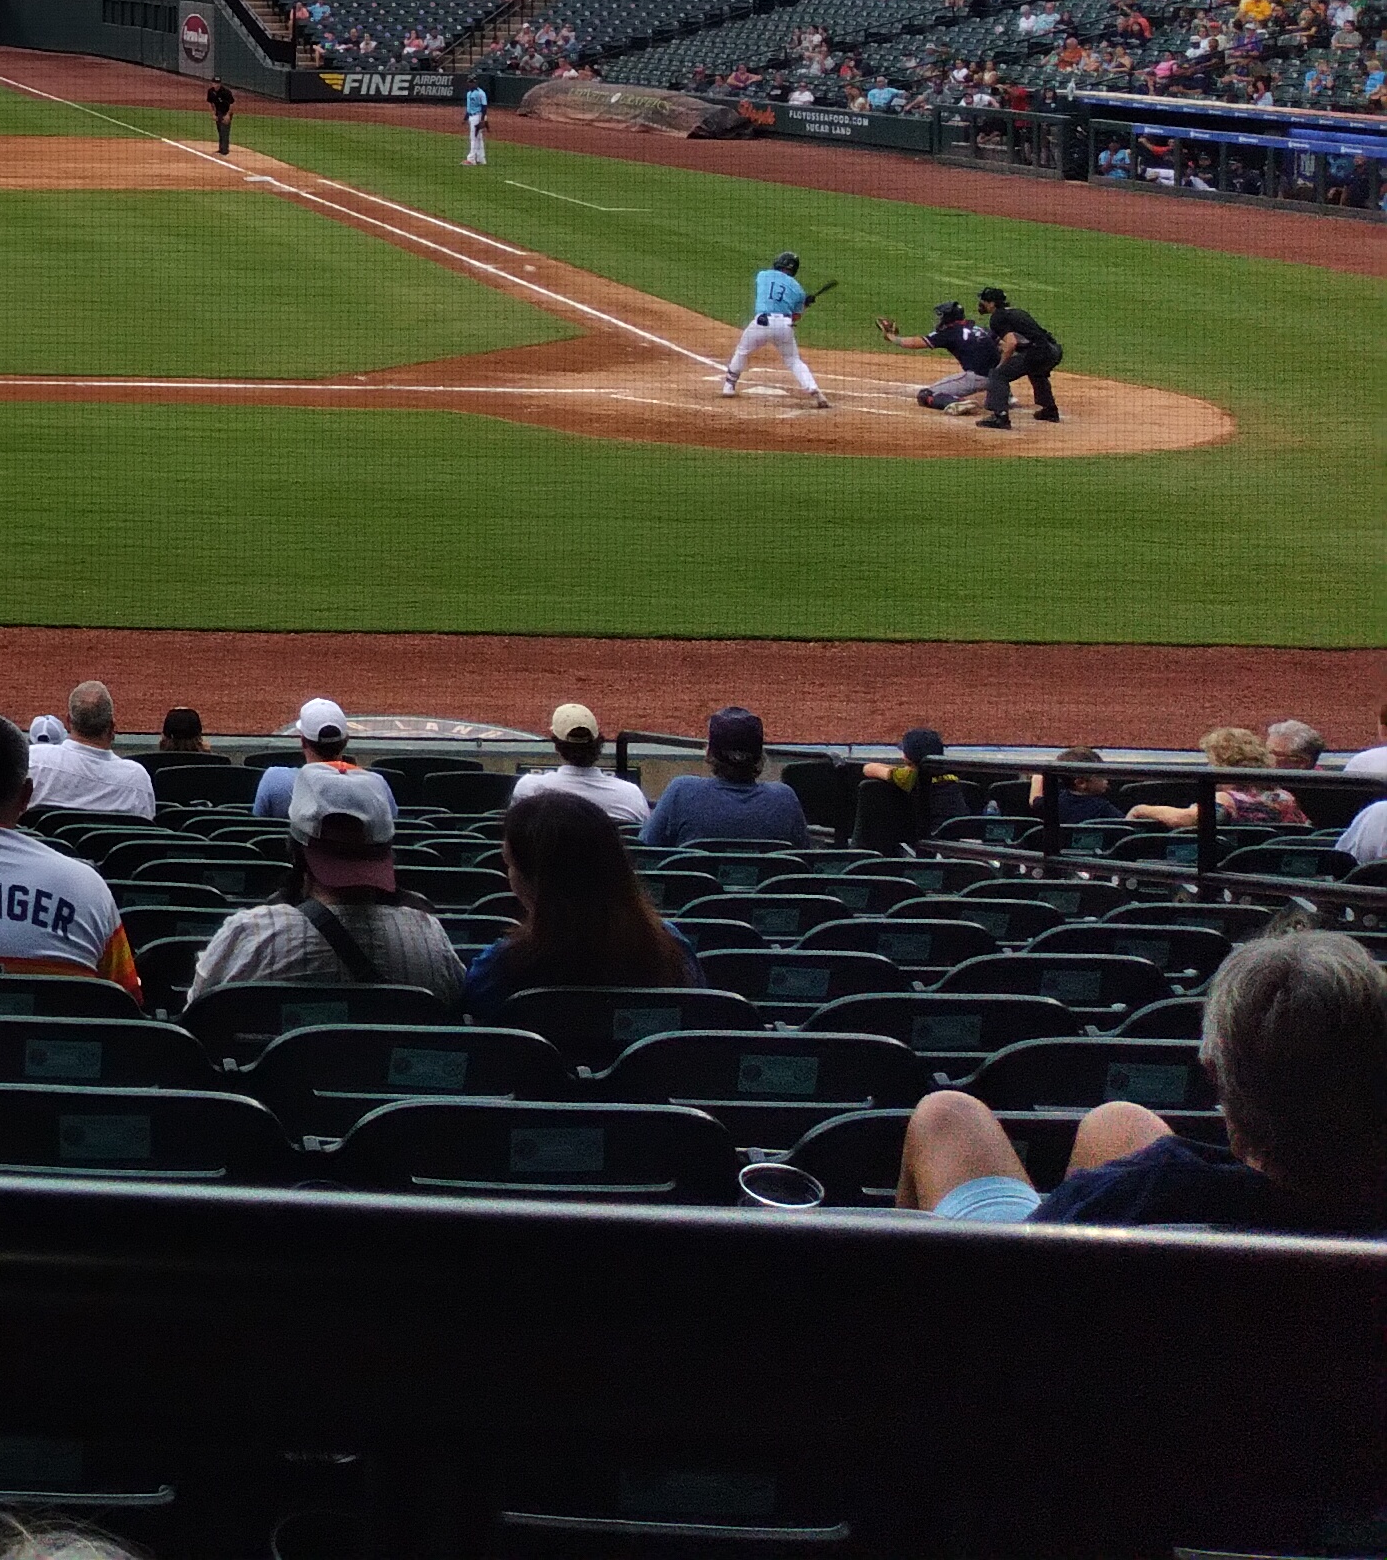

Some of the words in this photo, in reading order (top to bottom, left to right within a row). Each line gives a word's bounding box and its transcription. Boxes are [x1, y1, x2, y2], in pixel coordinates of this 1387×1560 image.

[344, 74, 412, 95] FINE
[413, 75, 454, 86] AIRPORT
[414, 86, 454, 96] PARKING
[789, 110, 868, 126] FLOYDSSEAFOOD.COM
[832, 126, 852, 135] LAND
[769, 281, 786, 303] 13
